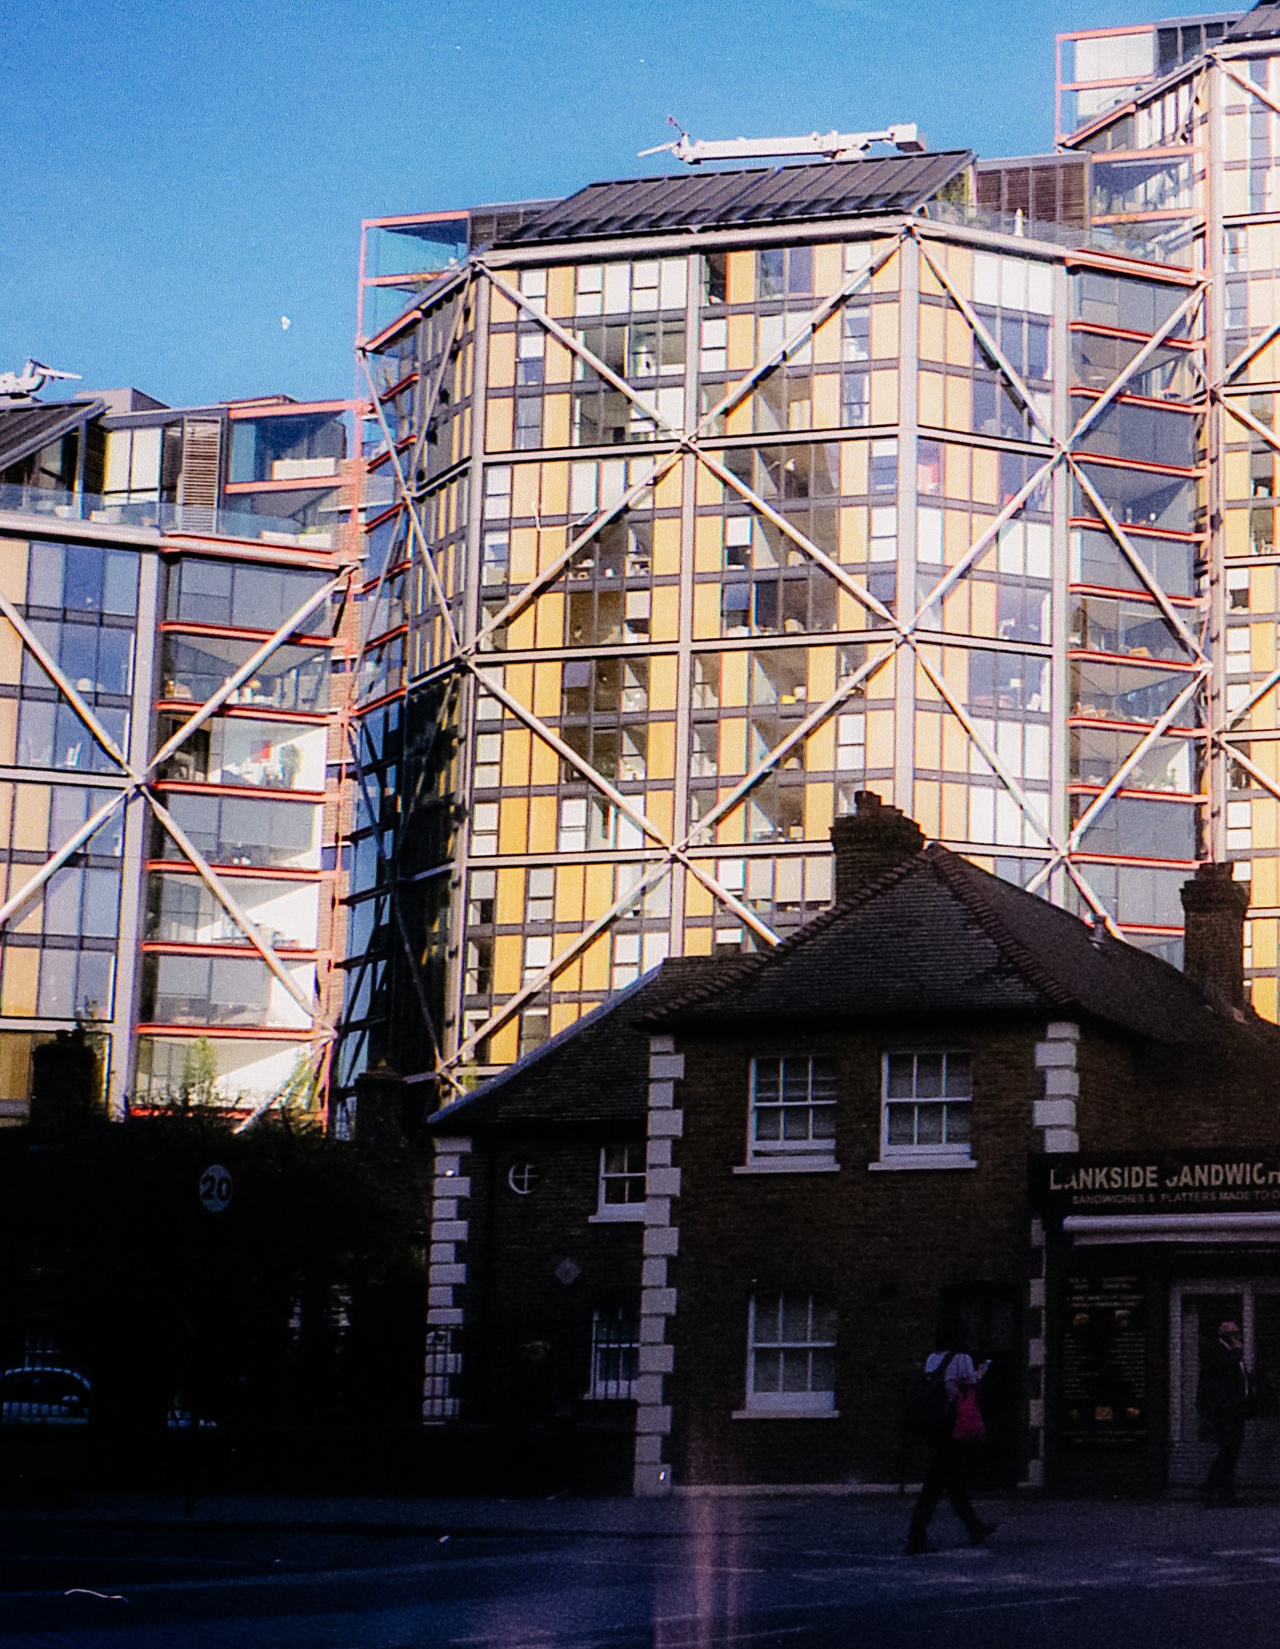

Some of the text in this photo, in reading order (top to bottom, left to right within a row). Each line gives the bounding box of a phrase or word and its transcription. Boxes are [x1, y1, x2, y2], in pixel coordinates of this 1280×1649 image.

[202, 1175, 230, 1202] 20
[1072, 1193, 1145, 1205] SANDWICHES
[1161, 1191, 1216, 1203] PLATTERS
[1219, 1190, 1250, 1201] MADE
[1255, 1190, 1269, 1200] TO
